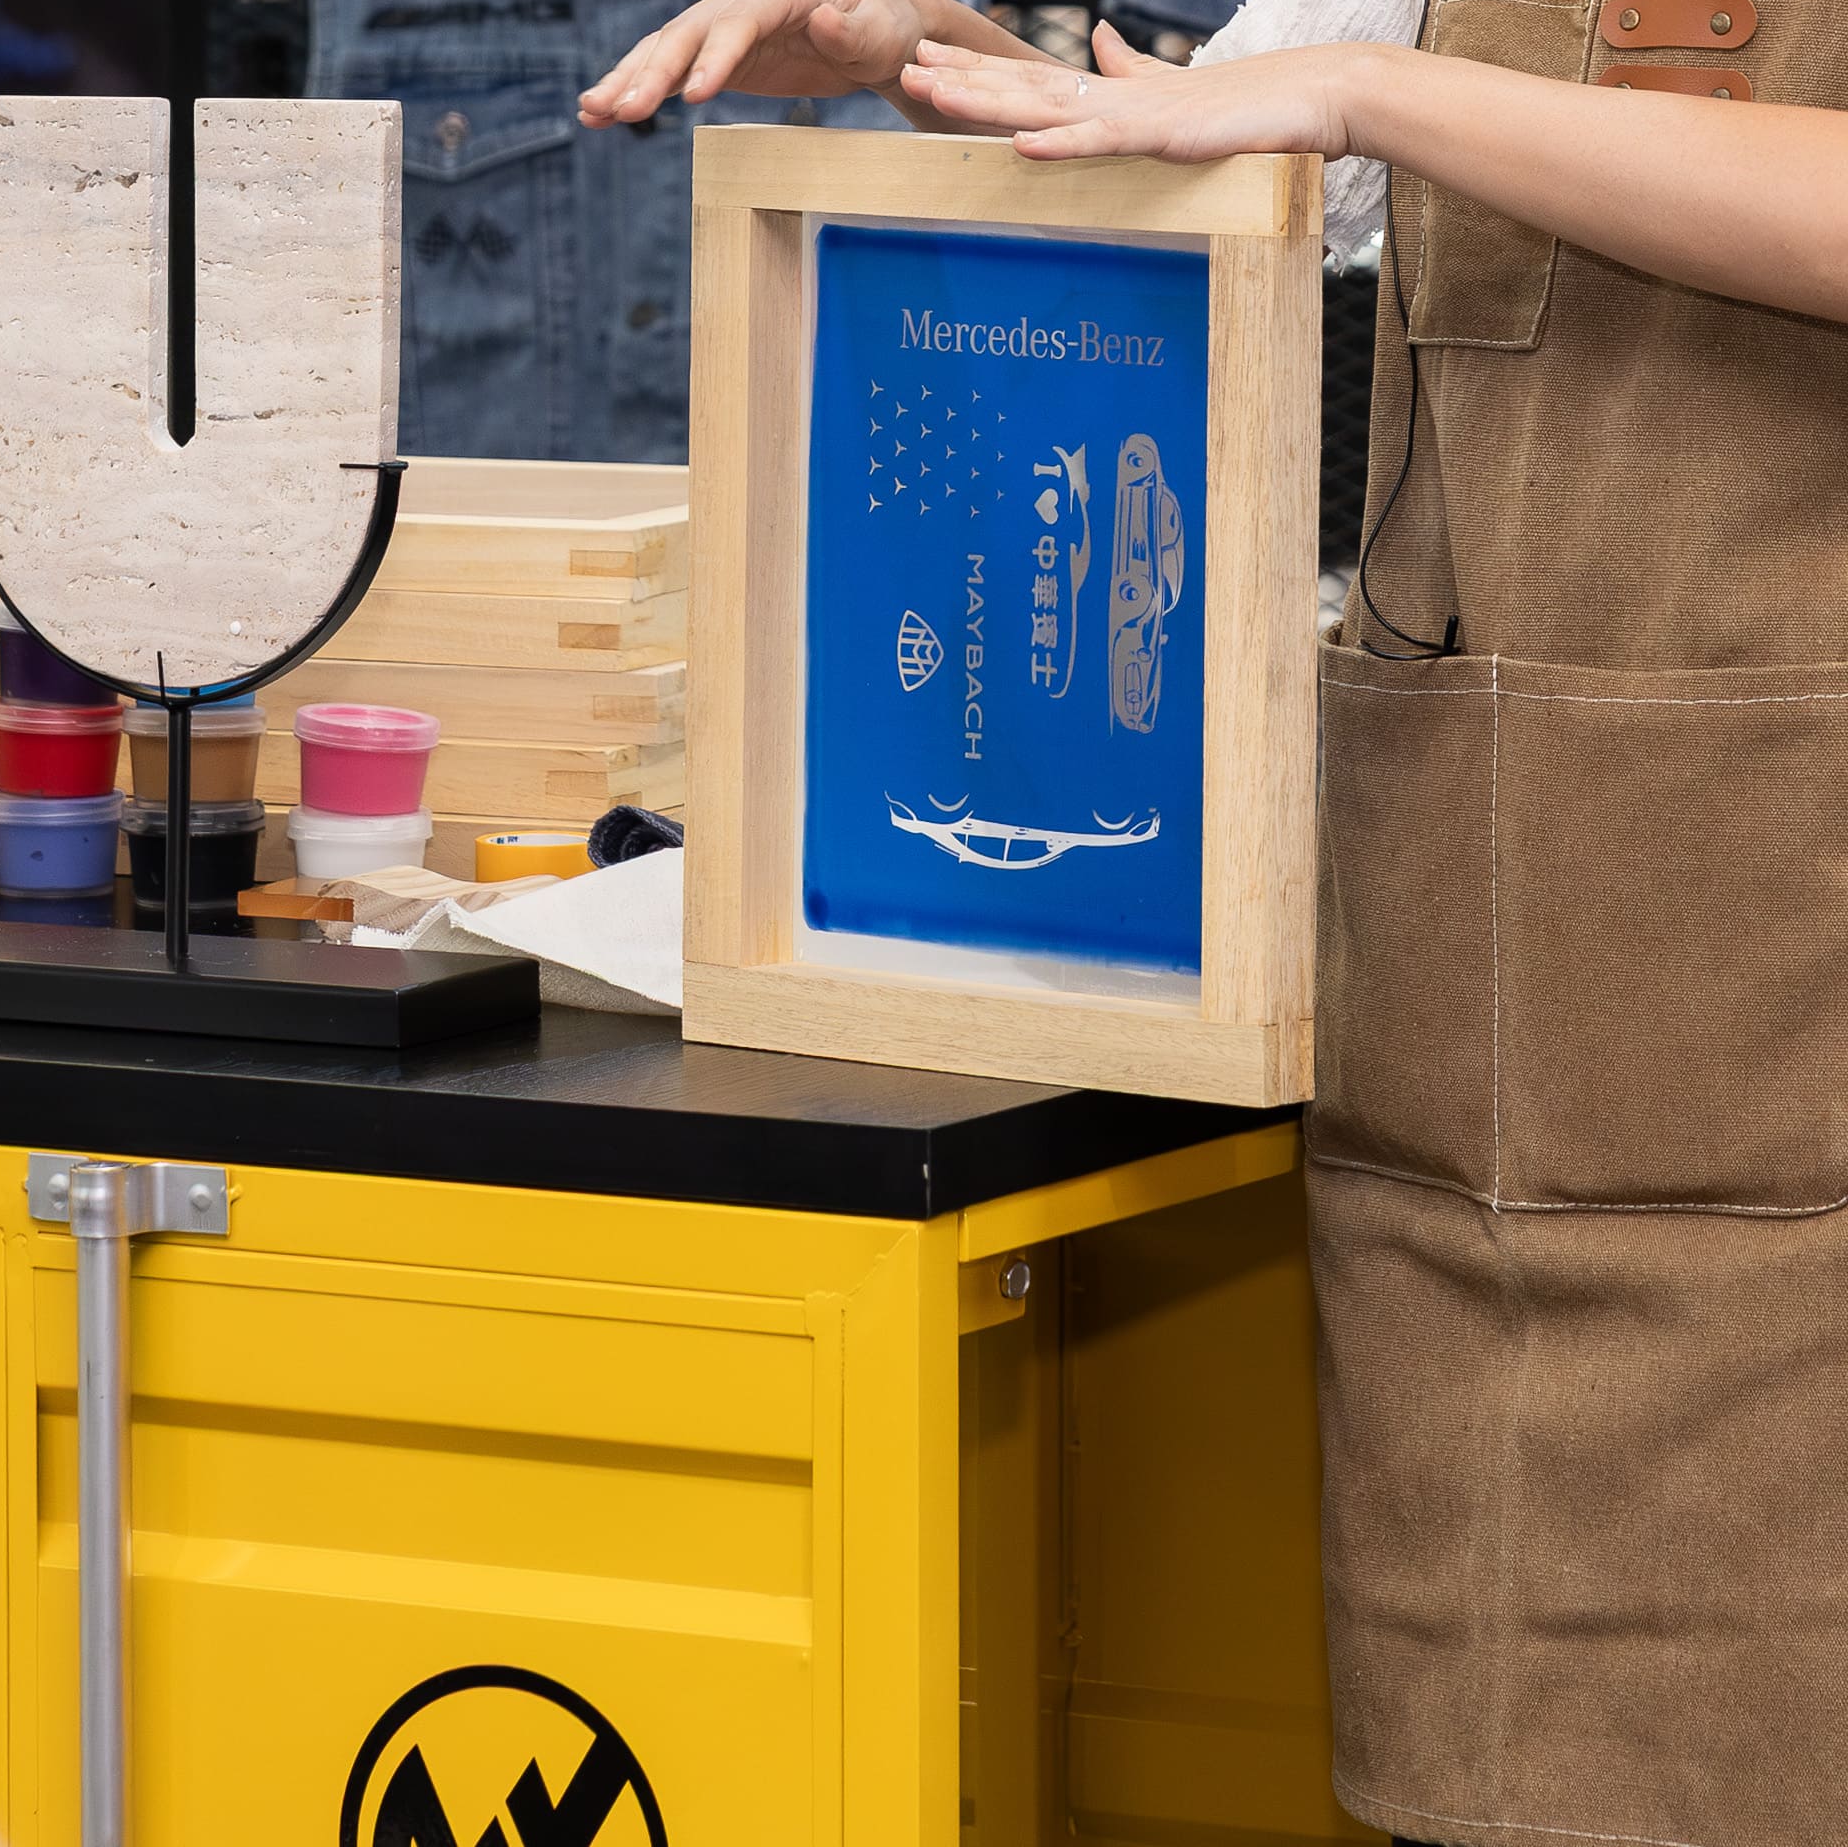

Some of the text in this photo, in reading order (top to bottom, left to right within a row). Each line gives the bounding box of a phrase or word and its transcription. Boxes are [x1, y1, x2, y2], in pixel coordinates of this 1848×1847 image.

[900, 308, 1165, 366] Mercedes-Benz
[964, 554, 985, 760] MAYBACH
[1031, 535, 1059, 688] 中華賓士
